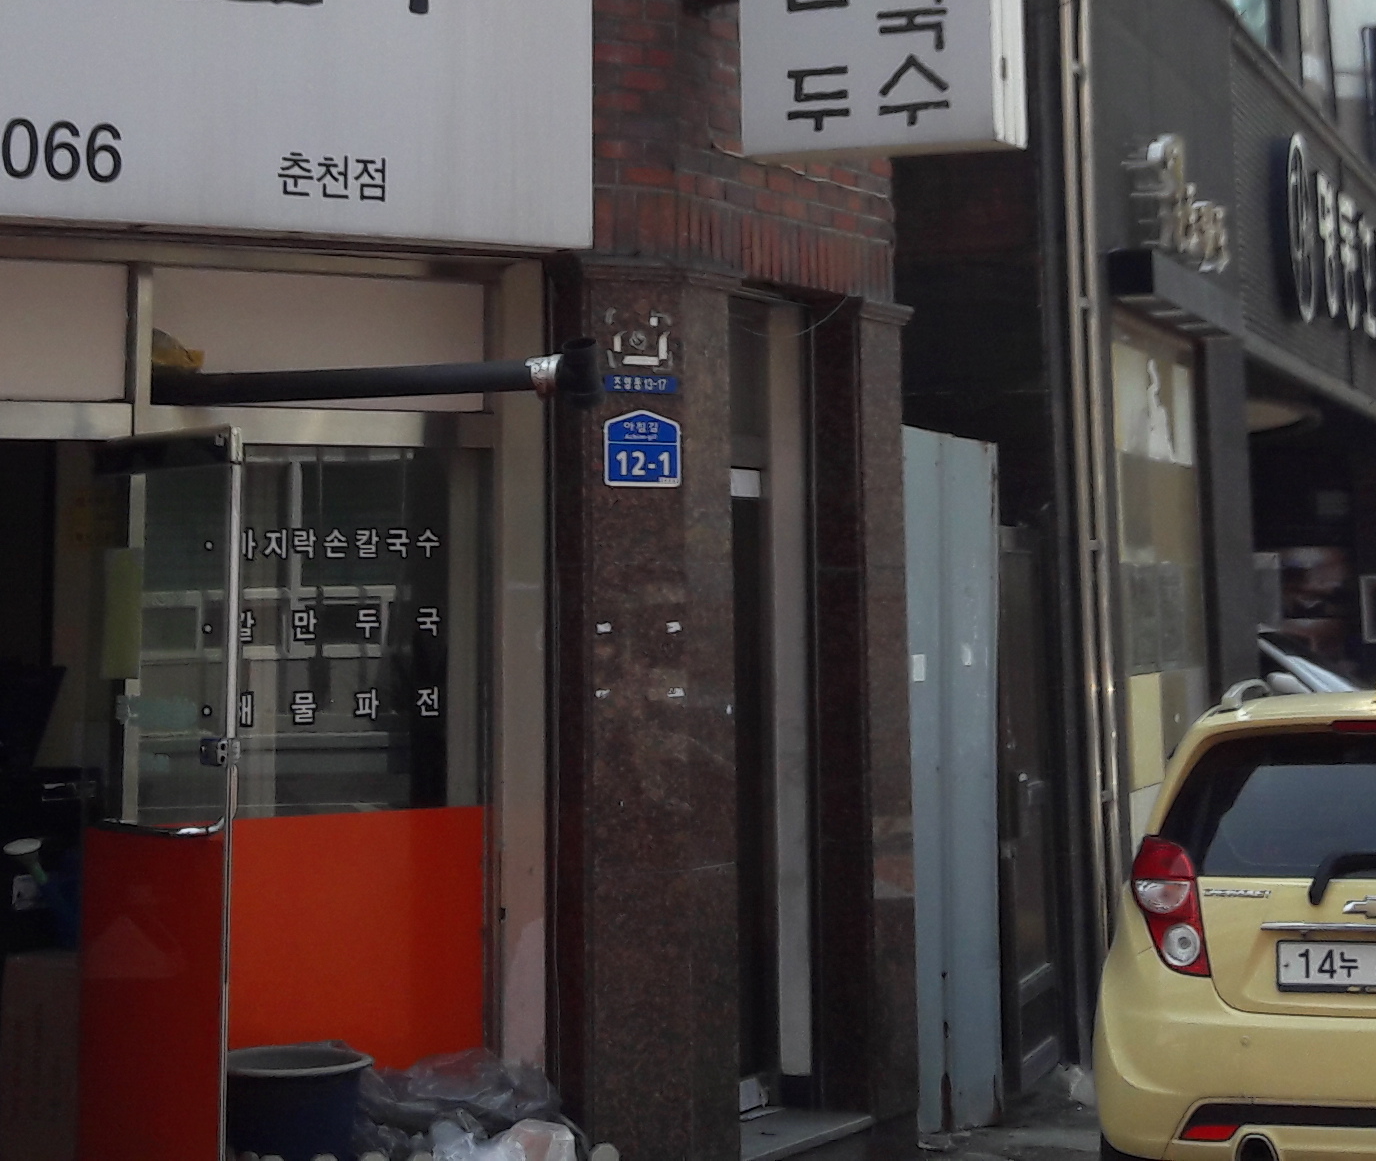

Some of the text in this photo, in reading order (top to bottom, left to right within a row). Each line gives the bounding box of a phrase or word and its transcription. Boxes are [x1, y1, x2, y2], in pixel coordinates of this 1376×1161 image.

[277, 152, 389, 203] 춘천점
[616, 450, 672, 477] 12-1
[1298, 948, 1359, 980] 14누
